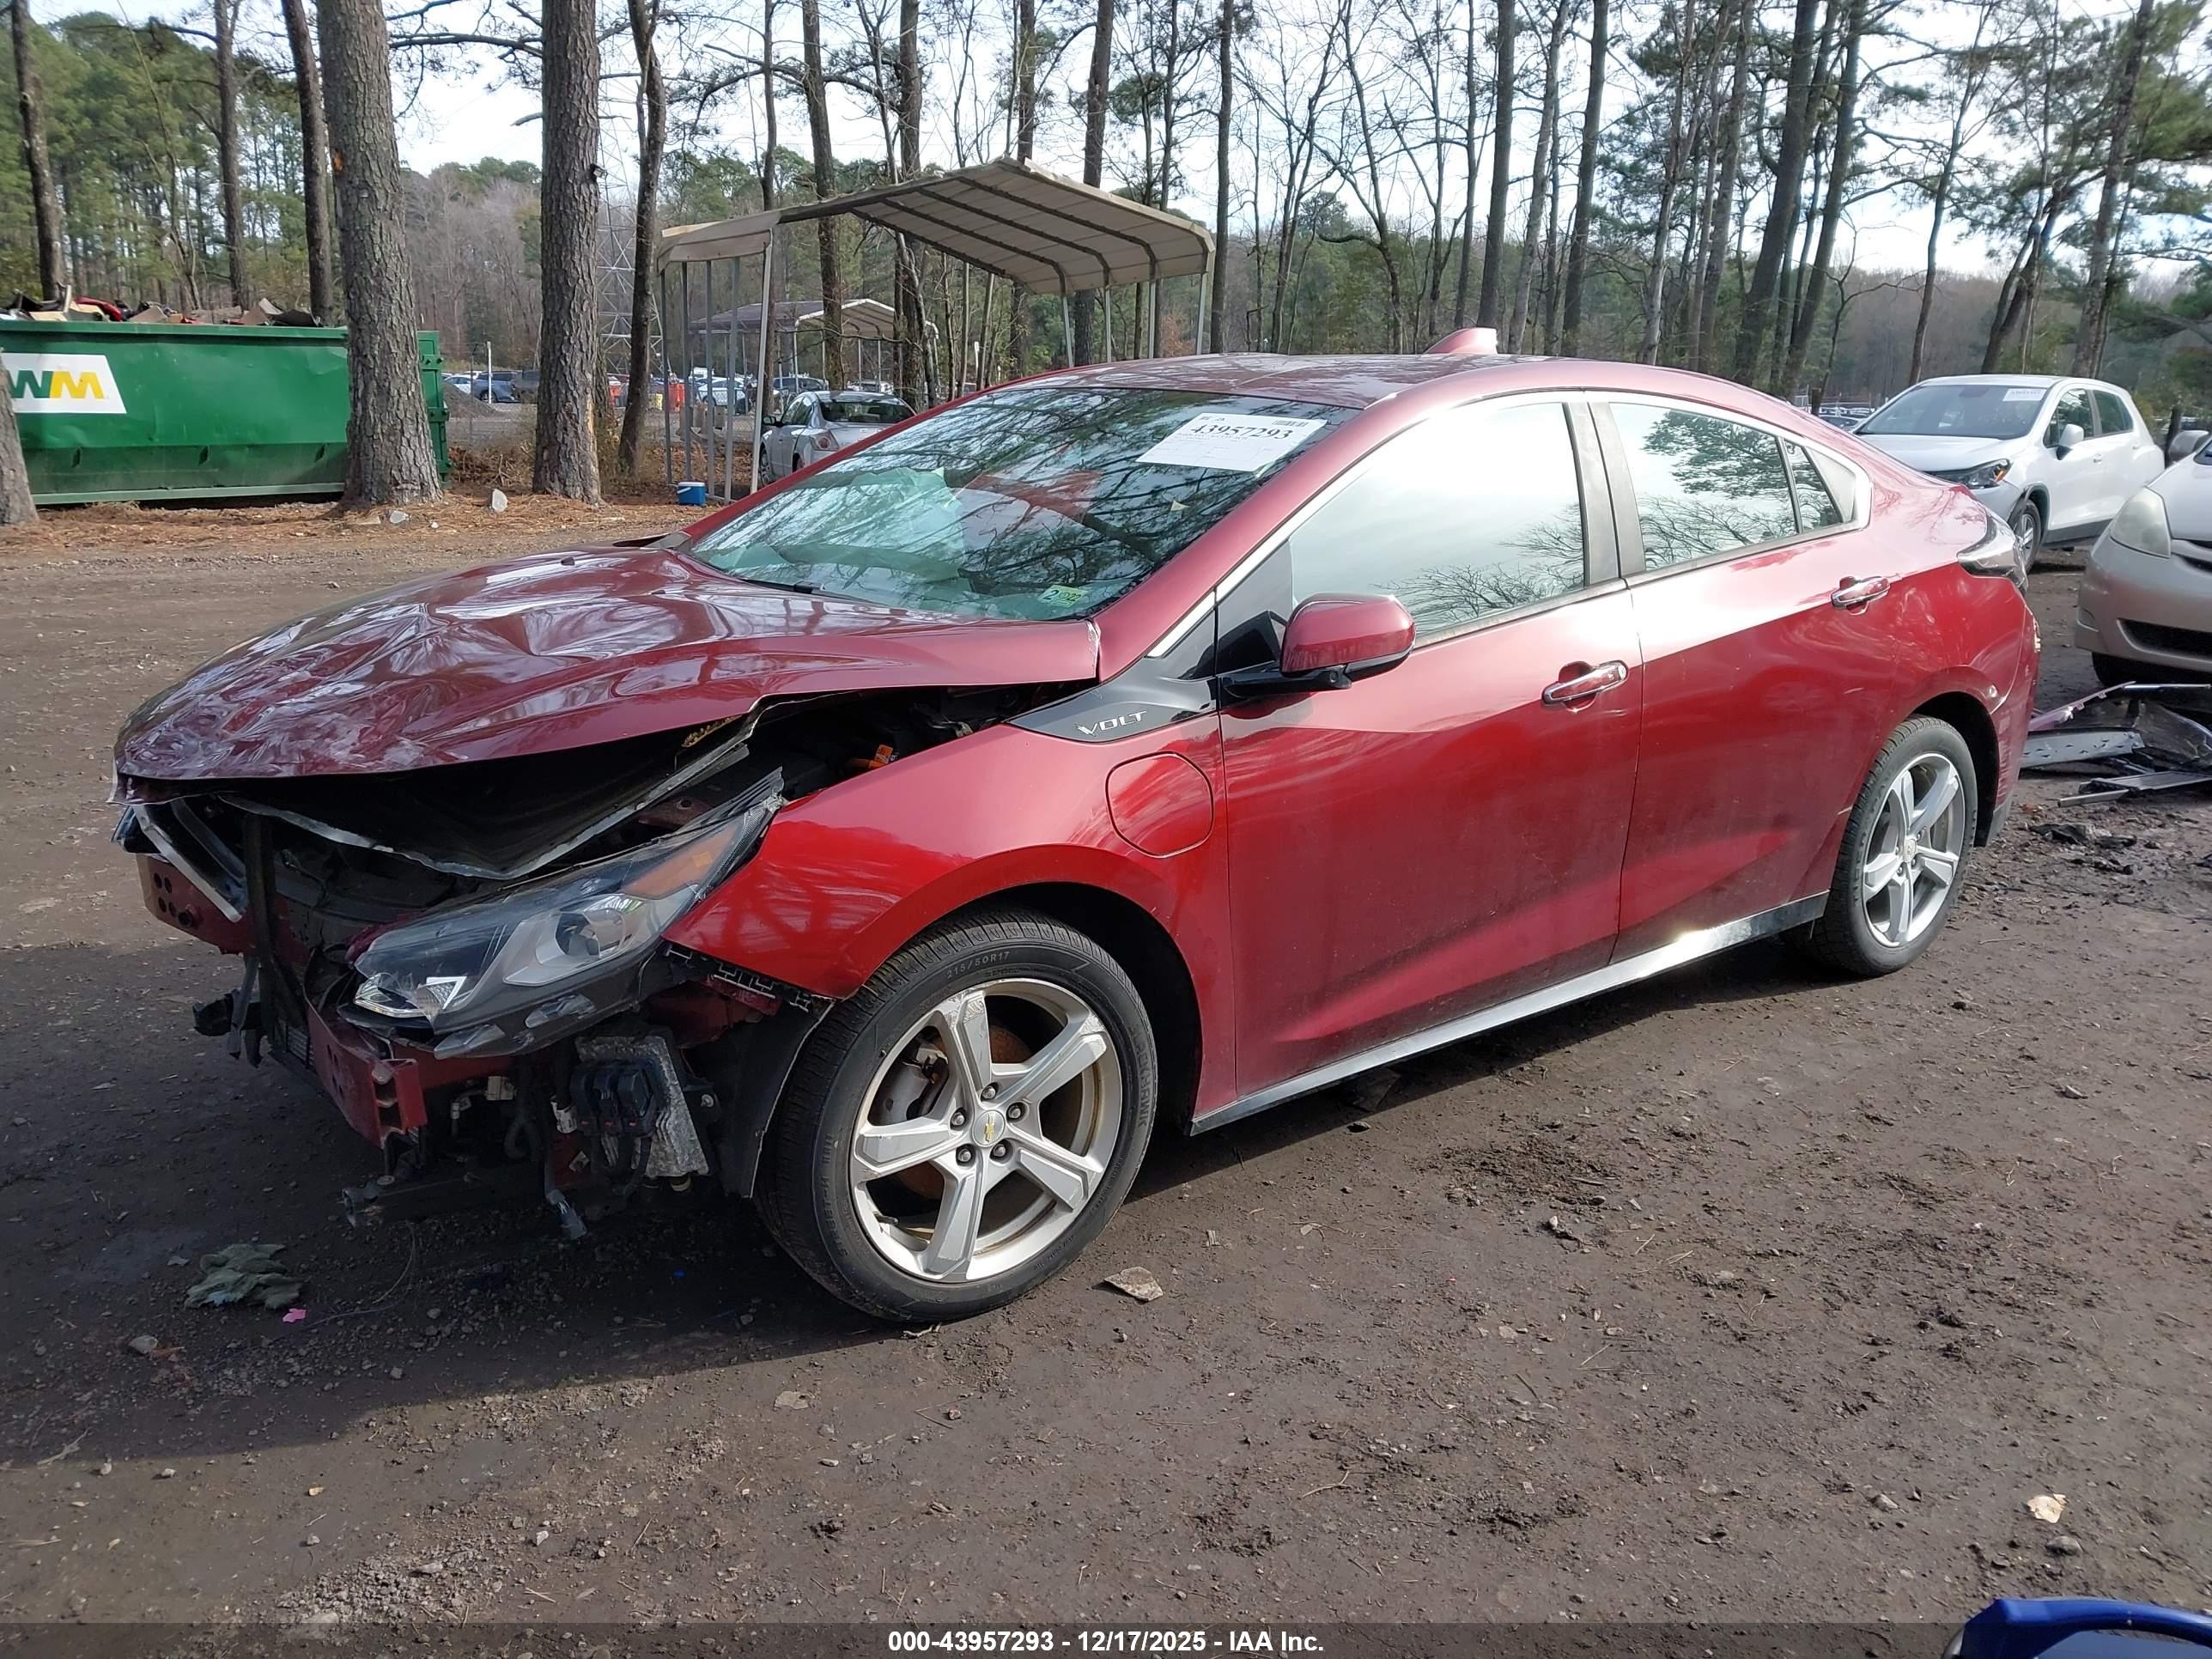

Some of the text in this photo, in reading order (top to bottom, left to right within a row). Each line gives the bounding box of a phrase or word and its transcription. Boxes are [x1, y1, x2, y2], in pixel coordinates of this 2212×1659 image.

[7, 370, 105, 398] WM
[1191, 423, 1294, 440] 43957293
[1042, 589, 1060, 600] 2
[1073, 710, 1147, 737] VOLT
[945, 951, 1010, 979] 215/50R17
